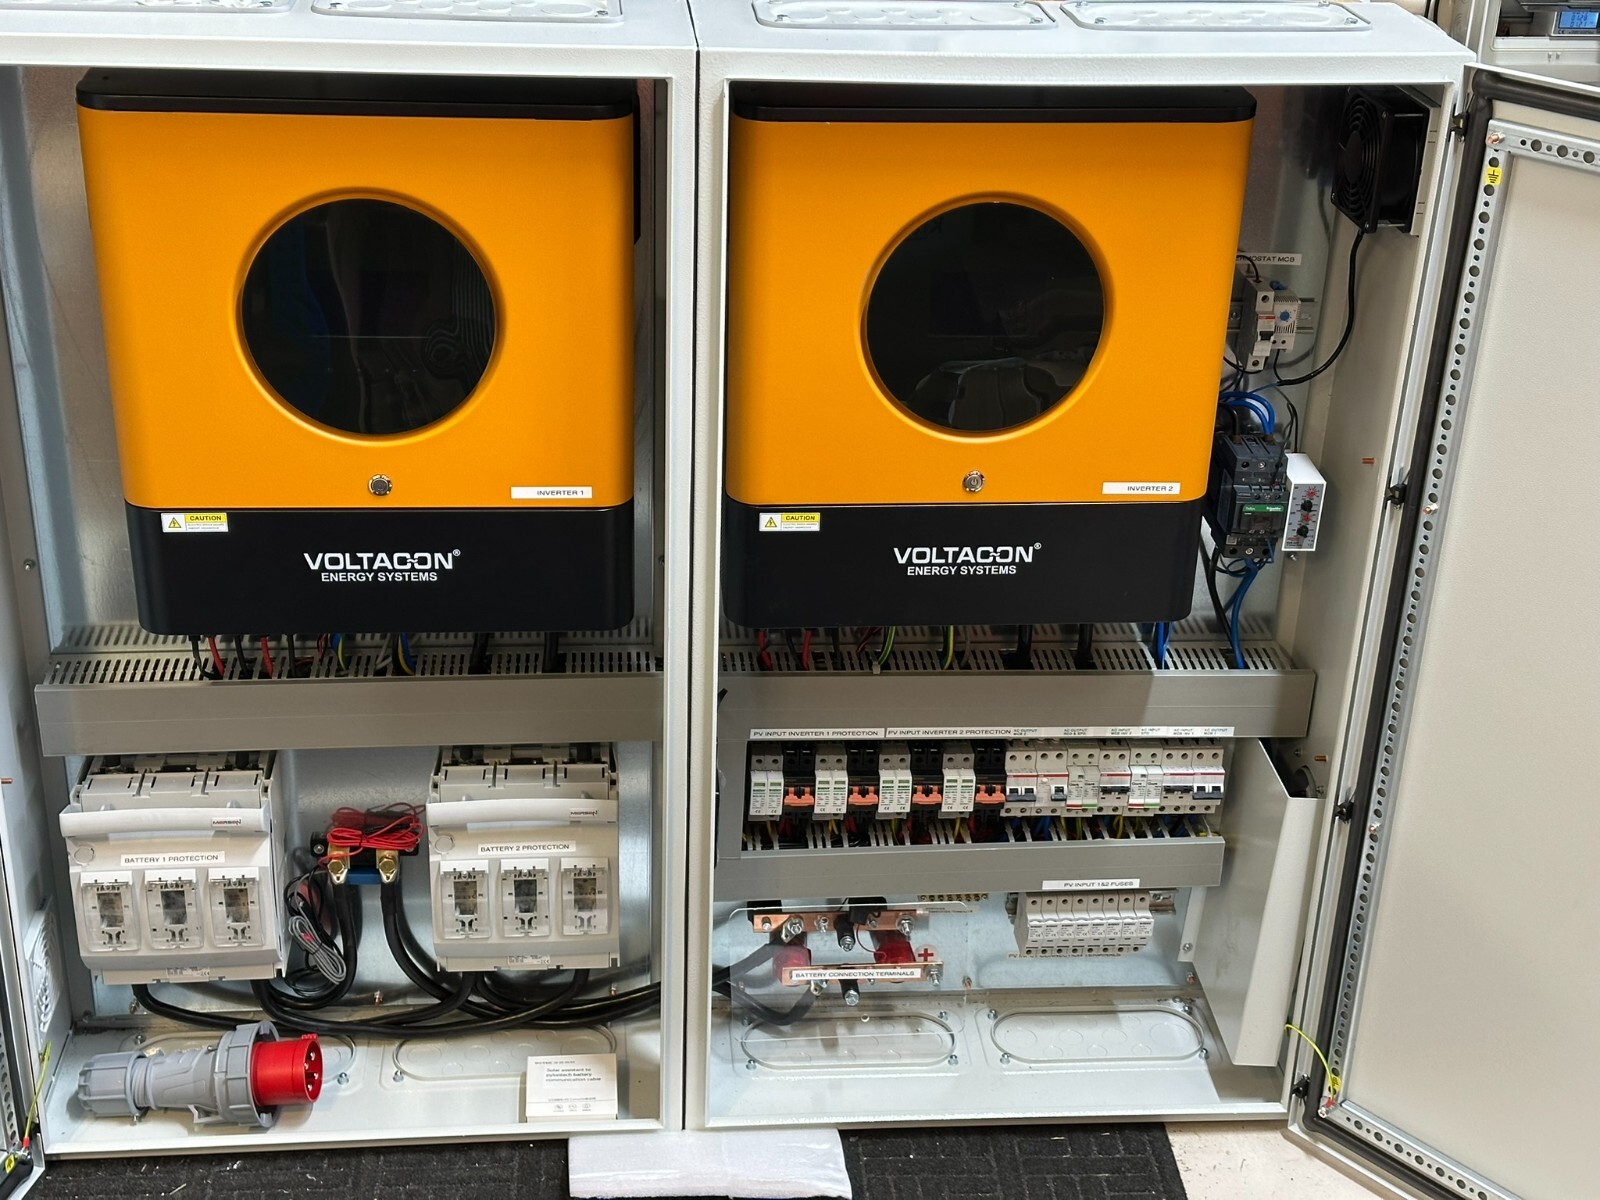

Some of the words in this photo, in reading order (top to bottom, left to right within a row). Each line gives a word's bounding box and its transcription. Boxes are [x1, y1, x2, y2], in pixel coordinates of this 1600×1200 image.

[907, 566, 958, 576] ENERGY
[959, 565, 1017, 575] SYSTEMS
[321, 572, 375, 582] ENERGY
[377, 572, 438, 582] SYSTEMS
[522, 843, 570, 851] PROTECTION
[124, 856, 160, 864] BATTERY
[168, 854, 219, 862] PROTECTION
